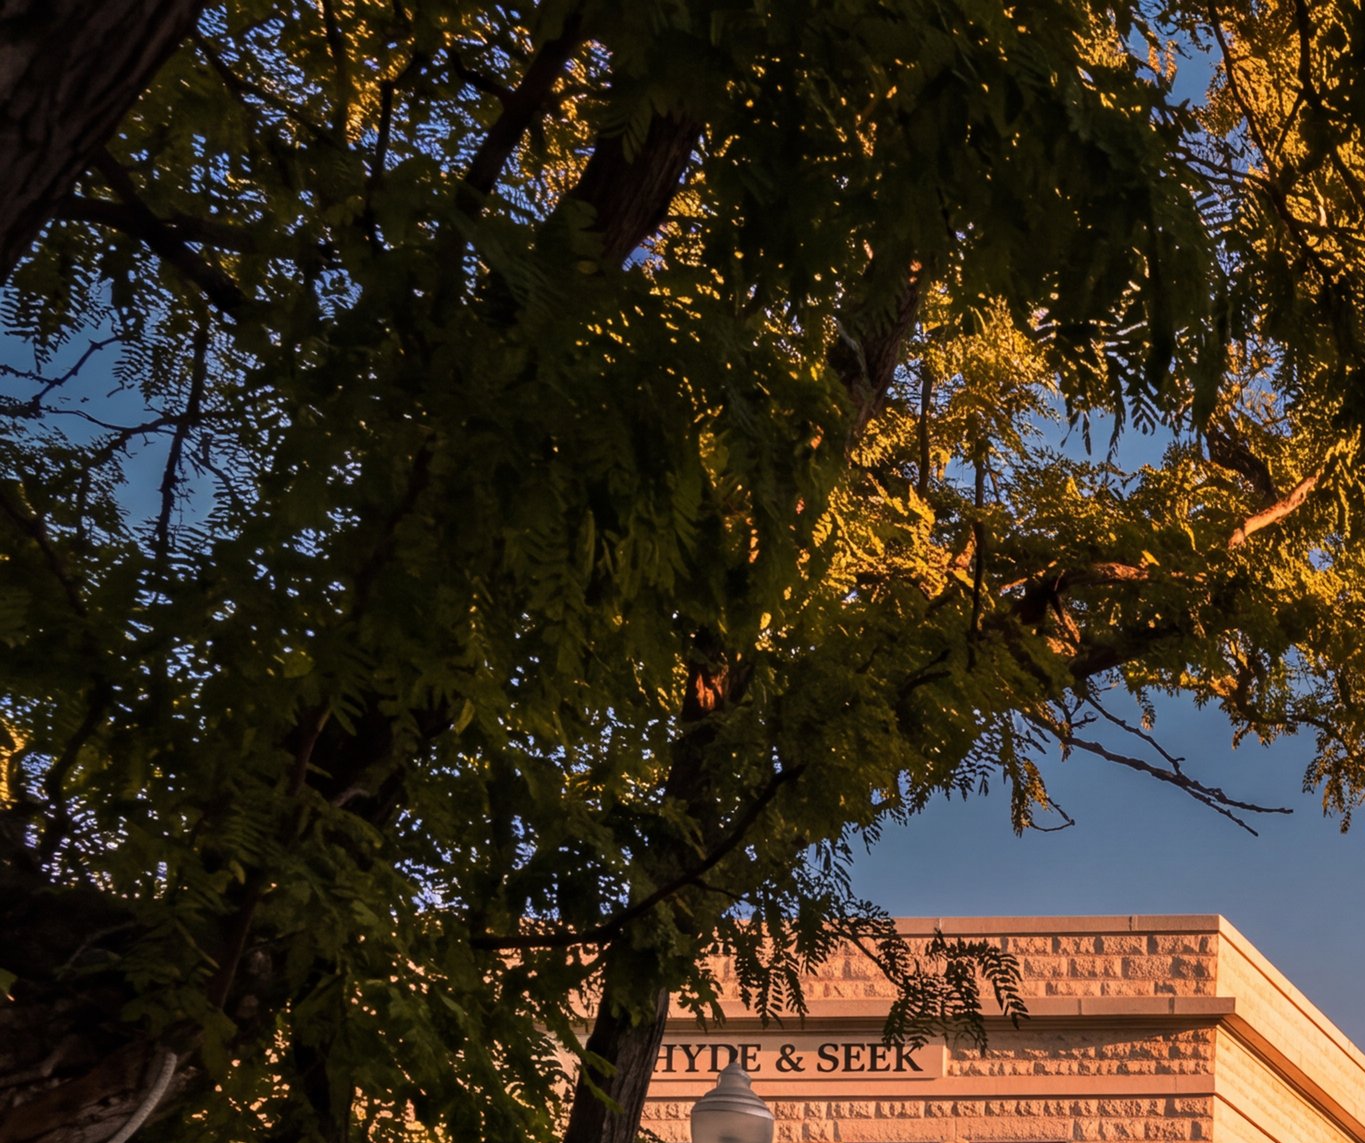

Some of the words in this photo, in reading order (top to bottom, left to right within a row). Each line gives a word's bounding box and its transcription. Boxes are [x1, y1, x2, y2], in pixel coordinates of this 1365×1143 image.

[652, 1043, 762, 1073] HYDE
[775, 1043, 806, 1073] &
[816, 1043, 924, 1073] SEEK
